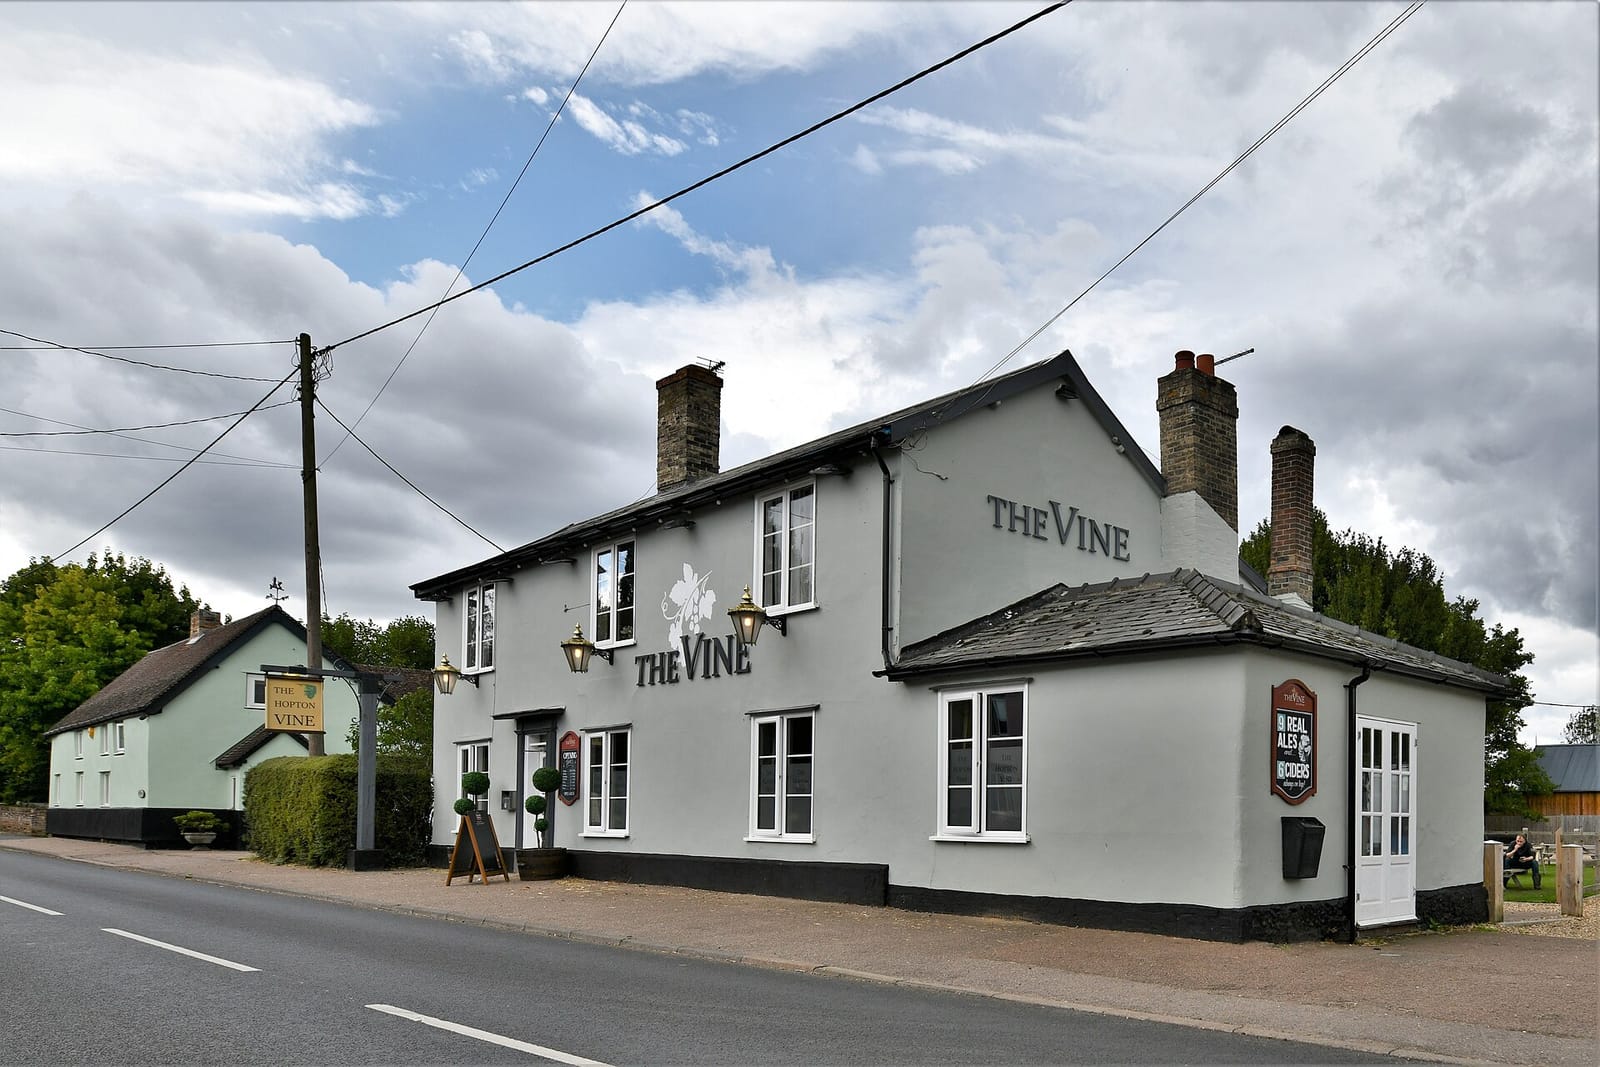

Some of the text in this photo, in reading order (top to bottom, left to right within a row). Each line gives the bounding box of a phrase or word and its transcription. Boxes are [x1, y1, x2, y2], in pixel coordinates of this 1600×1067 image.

[987, 494, 1130, 562] THE VINE
[635, 632, 752, 687] THE VINE
[273, 687, 294, 695] THE
[274, 700, 316, 709] HOPTON
[274, 713, 316, 727] VINE
[1278, 715, 1307, 734] 9 REAL
[1277, 732, 1298, 749] ALES
[1278, 762, 1310, 779] 6 CIDERS
